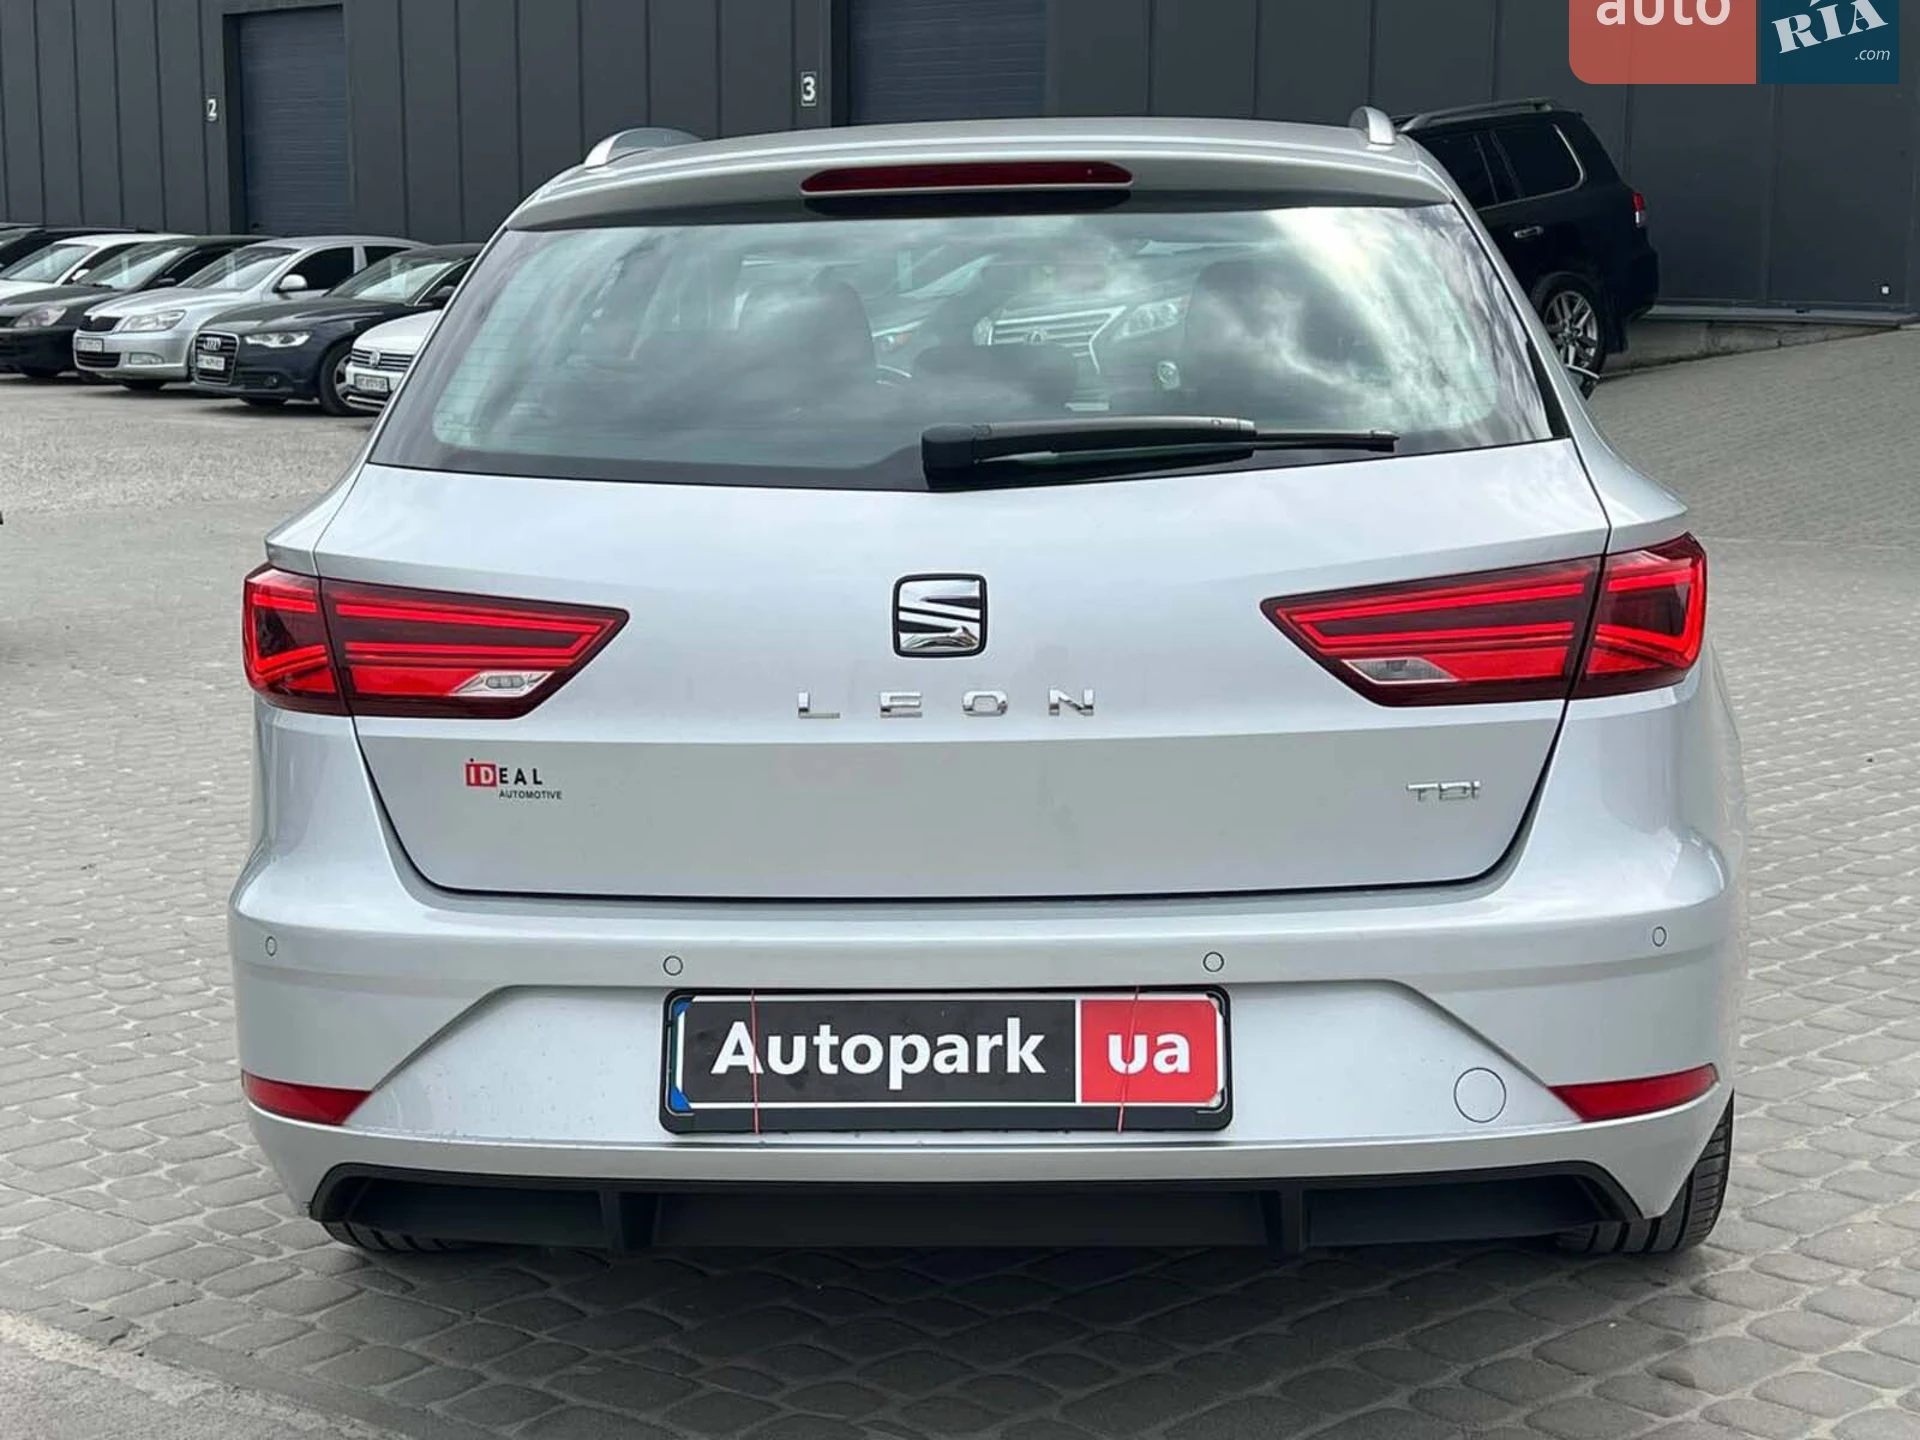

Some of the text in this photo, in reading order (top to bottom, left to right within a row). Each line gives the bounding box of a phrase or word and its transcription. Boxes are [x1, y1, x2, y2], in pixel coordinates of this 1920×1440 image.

[803, 76, 816, 101] 3
[208, 99, 217, 116] 2
[798, 688, 1095, 719] LEON
[498, 789, 562, 799] AUTOMOTIVE
[1406, 780, 1481, 801] TDI
[710, 1017, 1191, 1090] Autopark ua
